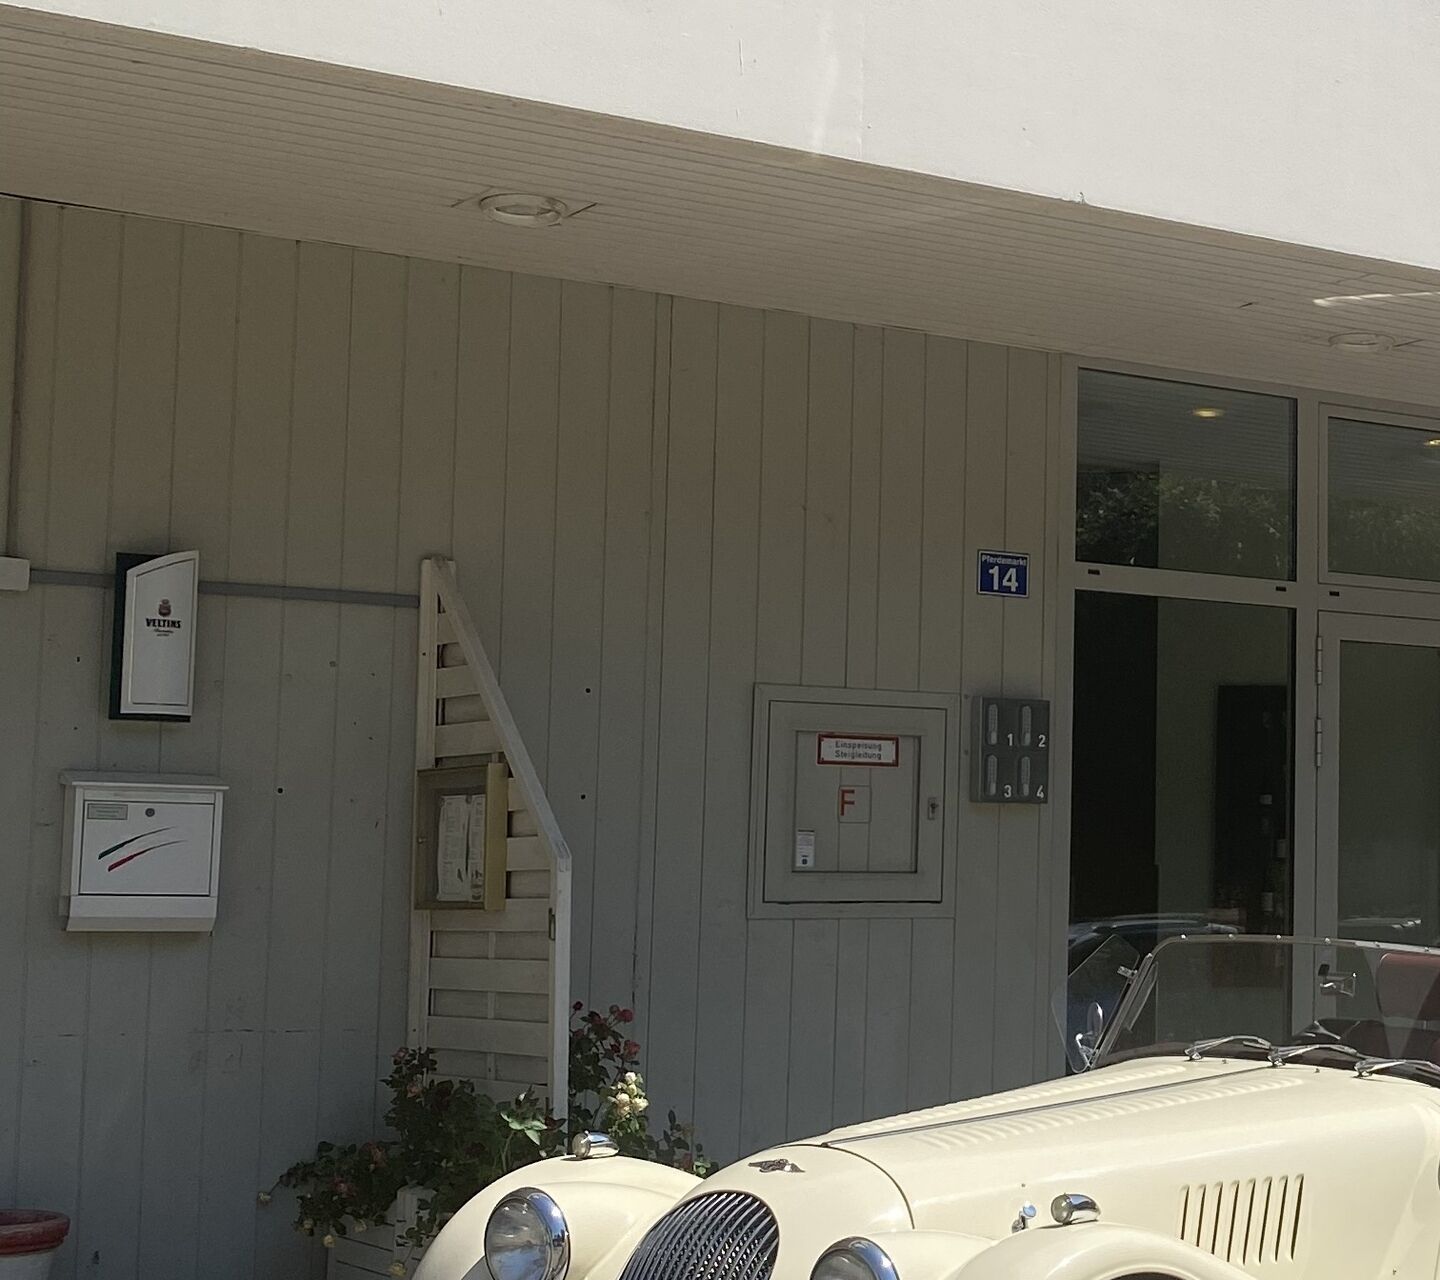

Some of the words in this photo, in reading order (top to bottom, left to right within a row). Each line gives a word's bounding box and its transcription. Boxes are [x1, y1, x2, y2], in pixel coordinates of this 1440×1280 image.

[988, 565, 1019, 593] 14
[145, 617, 182, 630] VELTINS
[1007, 733, 1014, 747] 1
[1038, 734, 1047, 748] 2
[1003, 784, 1013, 798] 3
[1035, 784, 1045, 799] 4
[839, 789, 856, 817] F
